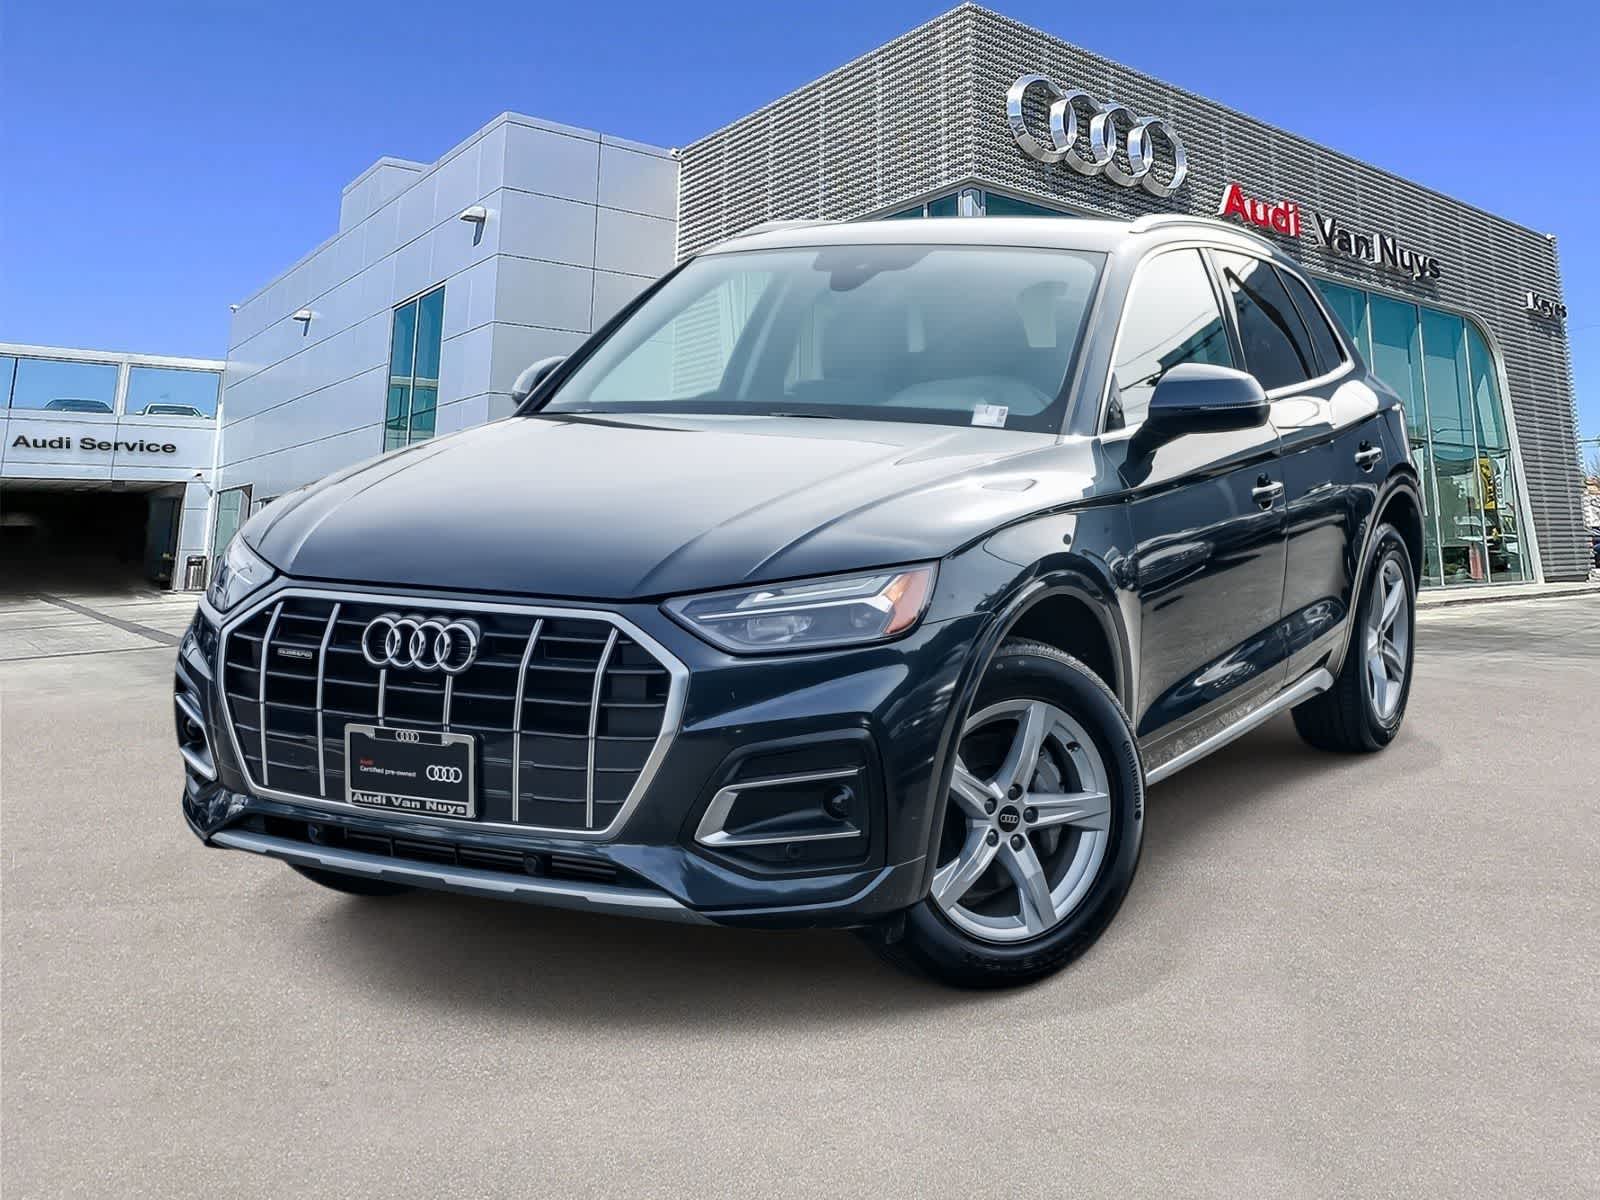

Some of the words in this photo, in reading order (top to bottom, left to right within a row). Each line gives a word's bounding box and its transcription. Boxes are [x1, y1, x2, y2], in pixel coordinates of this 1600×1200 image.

[1219, 182, 1302, 237] Audi
[1311, 214, 1374, 260] Van
[1373, 233, 1442, 280] Nuys
[12, 435, 71, 449] Audi
[79, 437, 177, 454] Service
[352, 792, 387, 805] Audi
[391, 796, 421, 809] Van
[425, 800, 466, 814] Nuys
